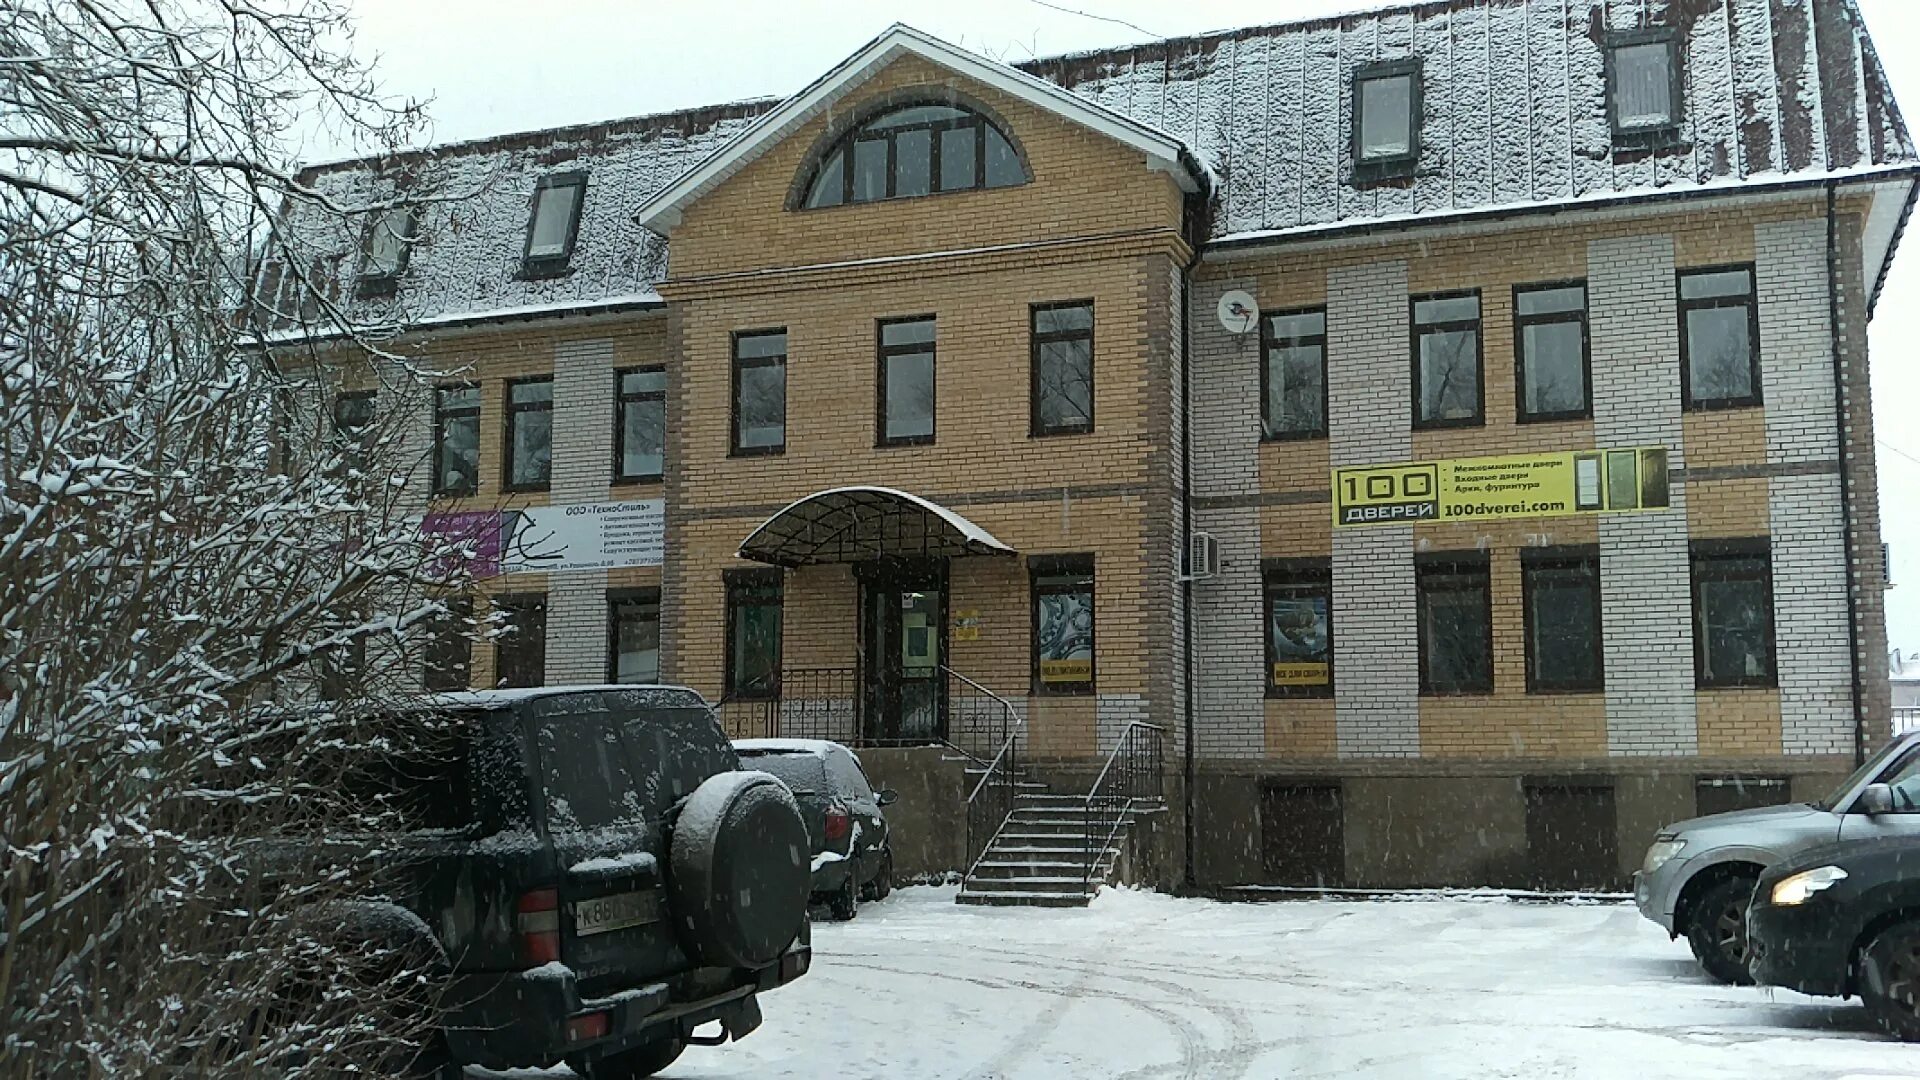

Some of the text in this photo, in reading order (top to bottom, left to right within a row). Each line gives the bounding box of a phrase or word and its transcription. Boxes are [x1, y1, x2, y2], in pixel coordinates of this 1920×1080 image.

[1454, 460, 1563, 472] Межкомнатные двери
[1454, 472, 1529, 482] Входные двери
[1345, 472, 1432, 500] 100
[1485, 481, 1540, 493] фурнитура
[565, 506, 586, 516] ООО
[1346, 502, 1433, 522] ДВЕРЕЙ
[1445, 500, 1565, 517] 100dverei.com
